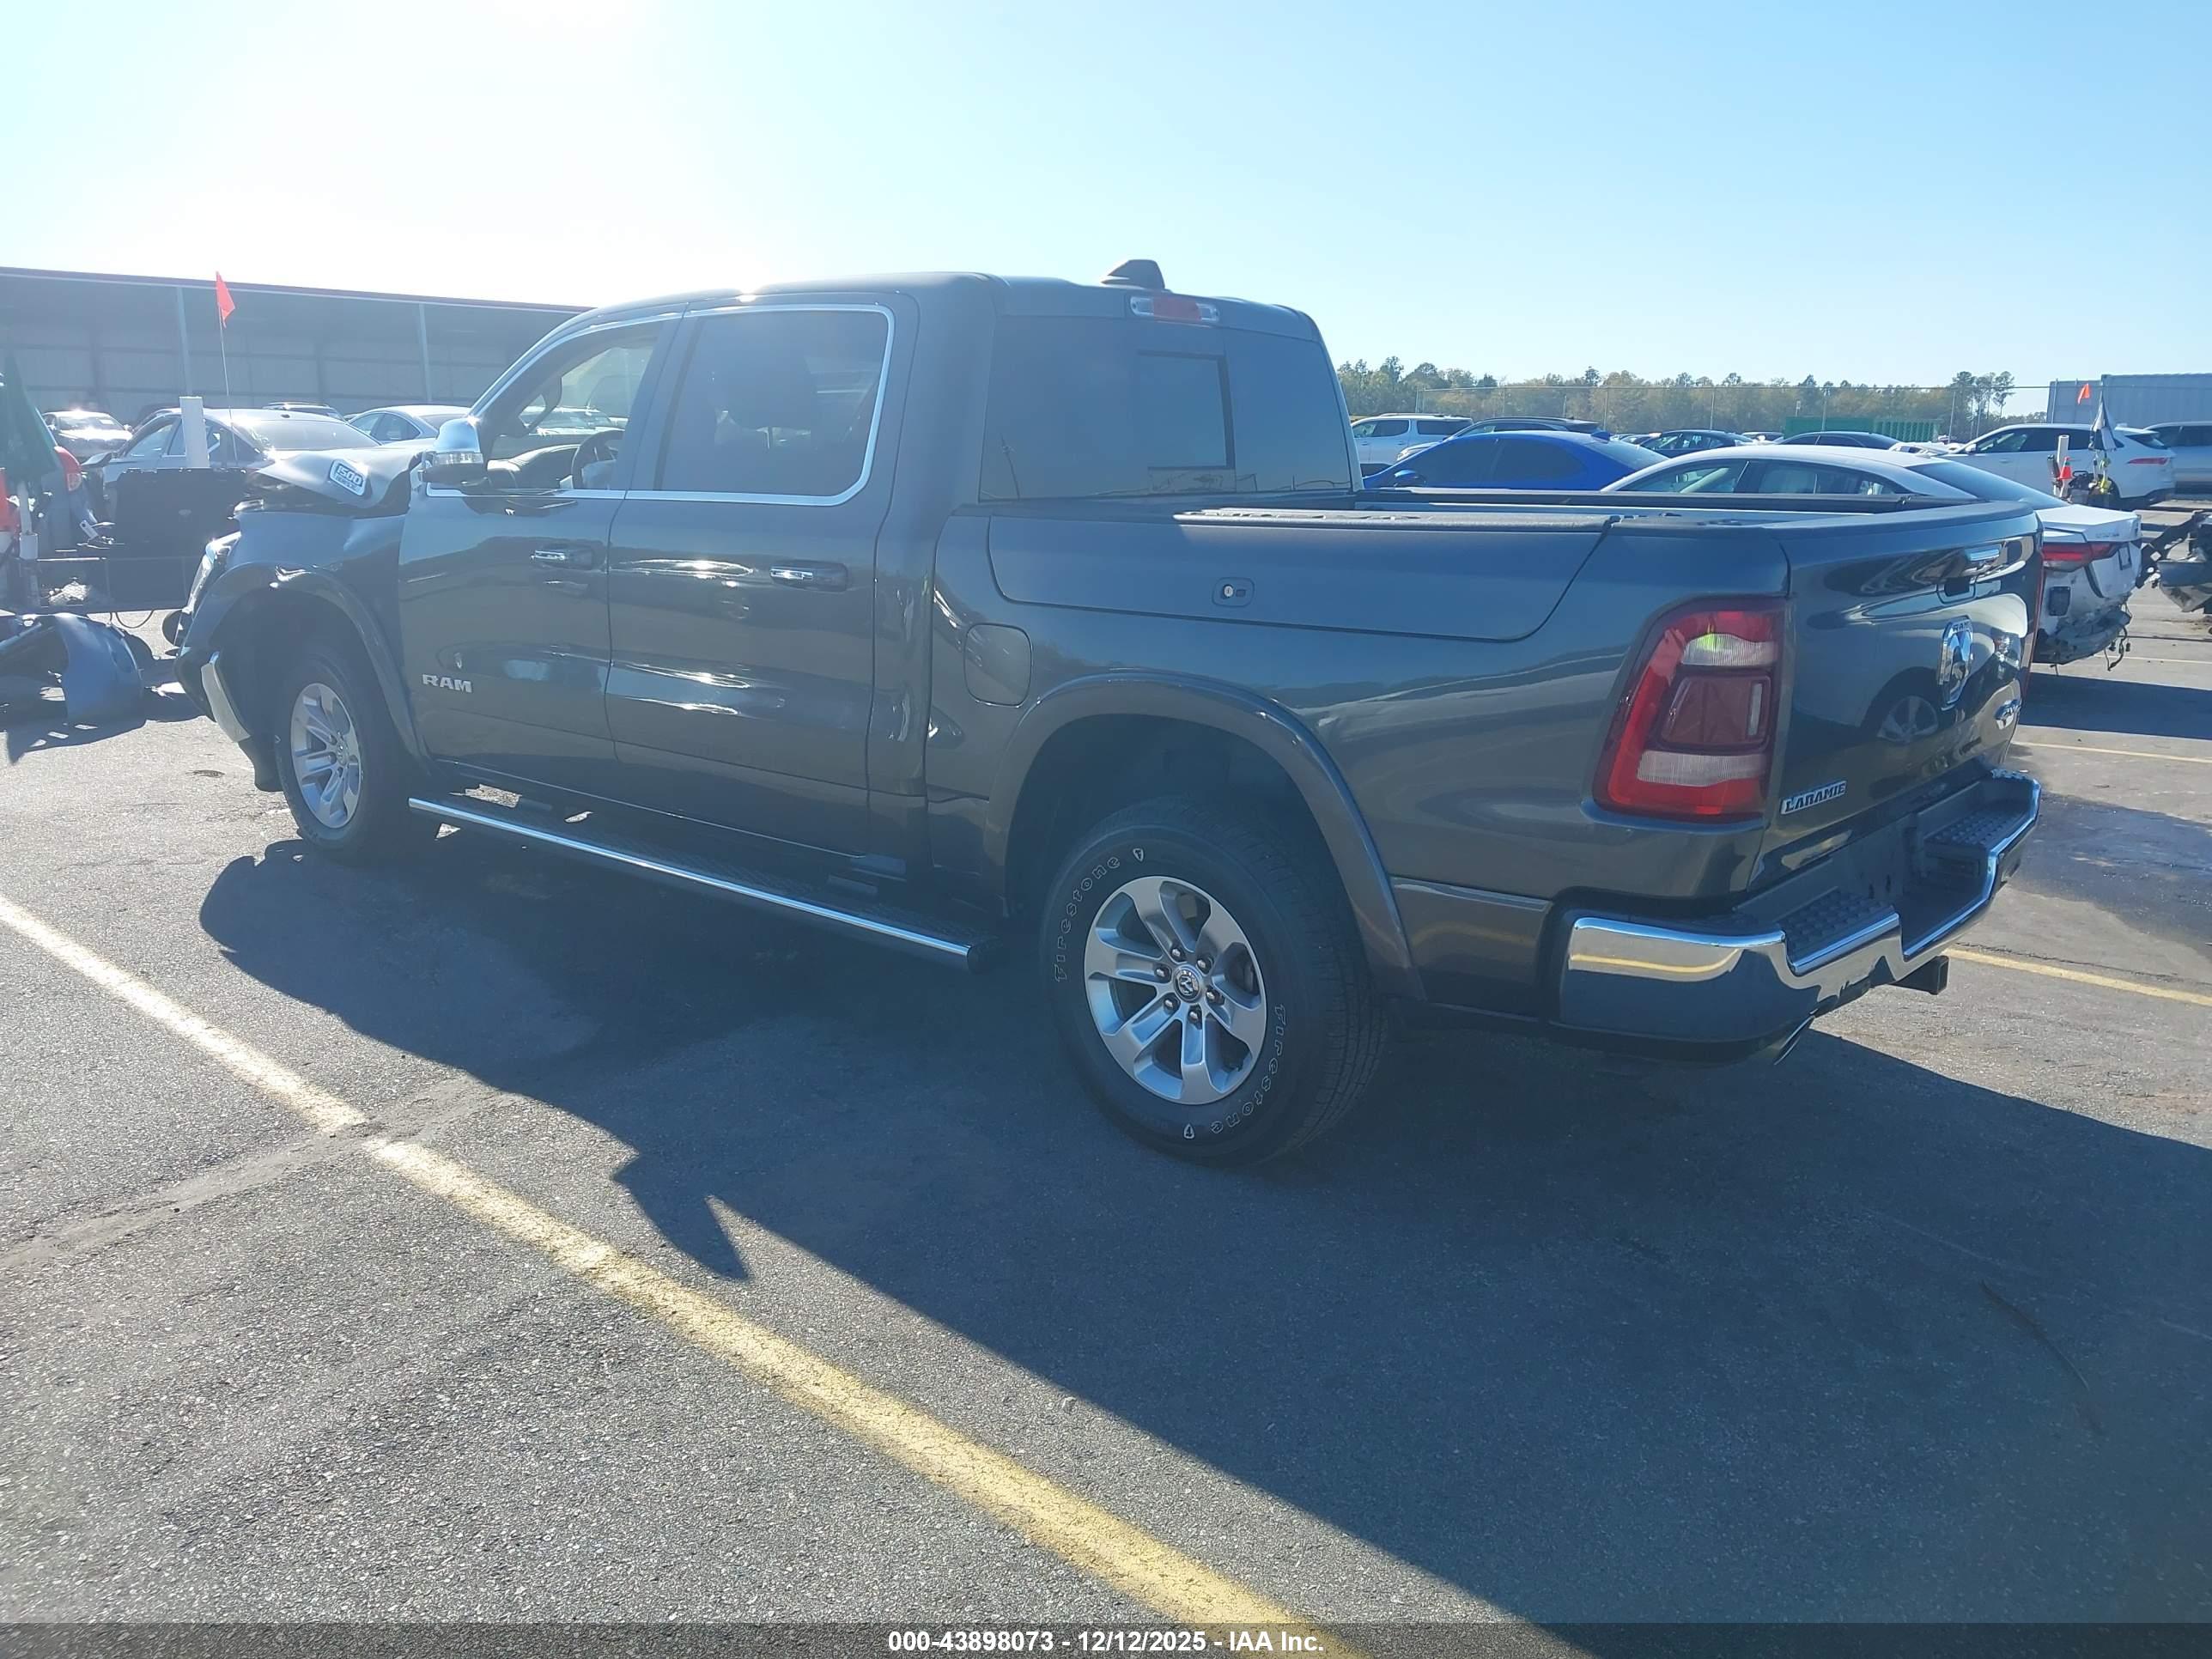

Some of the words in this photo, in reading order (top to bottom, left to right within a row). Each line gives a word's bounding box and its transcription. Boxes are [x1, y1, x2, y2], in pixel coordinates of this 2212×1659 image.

[337, 465, 362, 485] 1500
[422, 674, 472, 693] RAM
[1784, 782, 1846, 813] LARAMIE
[1054, 856, 1121, 983] Firestone
[1209, 1003, 1287, 1134] Firestone
